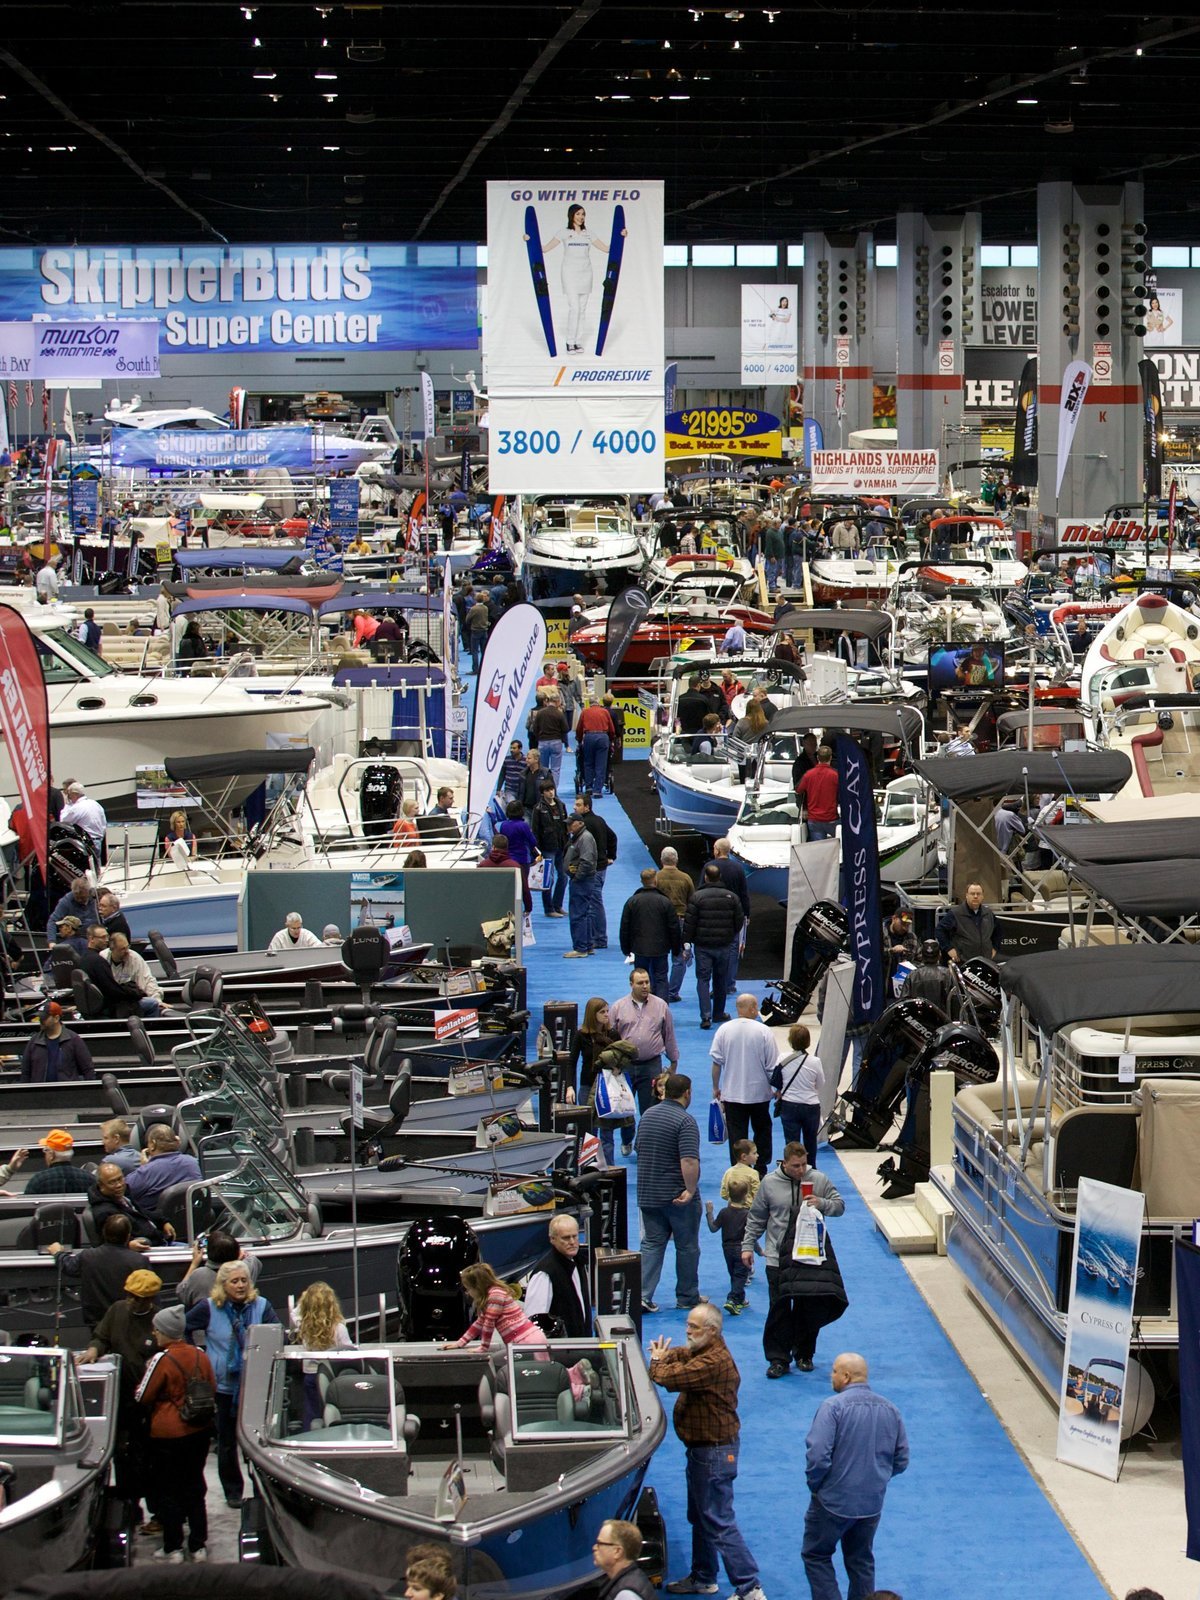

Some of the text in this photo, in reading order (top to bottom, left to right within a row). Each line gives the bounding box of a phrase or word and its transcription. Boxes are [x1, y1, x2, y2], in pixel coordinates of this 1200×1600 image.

[511, 190, 640, 201] GO WITH THE FLO
[981, 284, 1035, 297] Escalator to
[981, 301, 1037, 321] LOWE
[41, 326, 120, 344] munson
[165, 309, 382, 348] Super Center
[983, 325, 1037, 344] LEVE
[56, 347, 103, 357] marine
[11, 358, 31, 371] BAY
[116, 356, 151, 372] South
[744, 364, 795, 373] 4000 / 4200
[571, 370, 653, 382] PROGRESSIVE
[1099, 411, 1106, 423] K
[497, 430, 656, 454] 3800 / 4000
[697, 440, 724, 450] Motor
[727, 440, 737, 449] &
[740, 440, 771, 450] Trailer
[156, 453, 269, 467] Boating Super Center
[813, 453, 937, 466] HIGHLANDS YAMAHA
[814, 466, 936, 475] ILLINOIS #1 YAMAHA SUPERSTORE!
[863, 479, 897, 489] YAMAHA
[1061, 521, 1158, 542] malibu
[53, 850, 87, 878] MERCURY
[847, 756, 873, 1012] CYPRESS CAY
[811, 909, 847, 936] MERCURY
[353, 937, 379, 945] LUND
[1020, 936, 1038, 946] CAY
[962, 967, 1000, 998] MERCURY
[438, 1012, 477, 1035] Sellathon
[904, 1014, 933, 1041] MERC
[941, 1049, 995, 1080] MERCURY
[1173, 1058, 1195, 1069] CAY
[1080, 1311, 1113, 1331] CYPRESS
